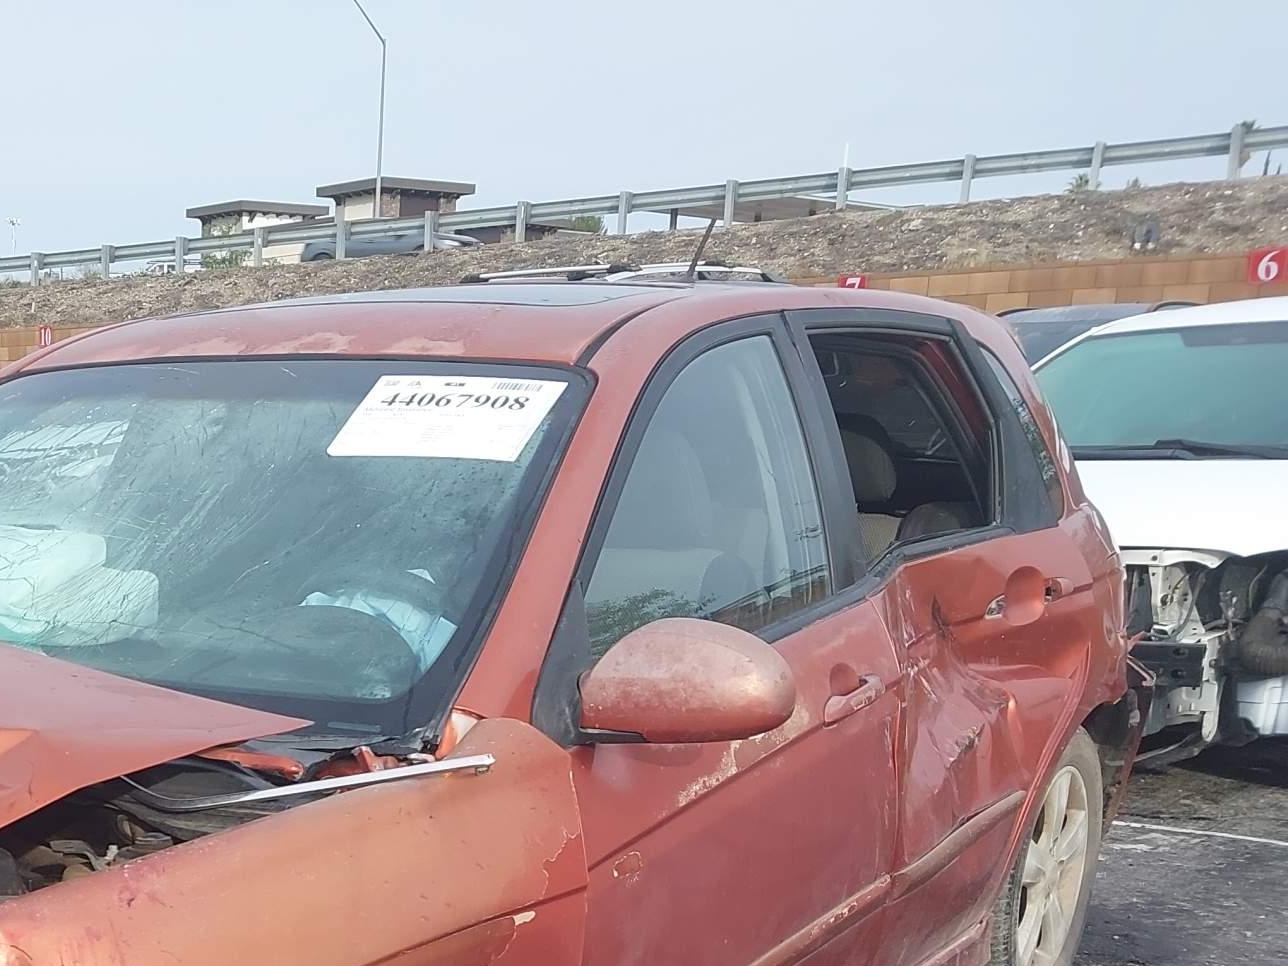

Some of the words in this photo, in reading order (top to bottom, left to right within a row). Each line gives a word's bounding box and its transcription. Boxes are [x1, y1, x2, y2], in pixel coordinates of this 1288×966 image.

[1257, 249, 1279, 281] 6
[40, 326, 52, 346] 10
[380, 392, 530, 410] 44067908
